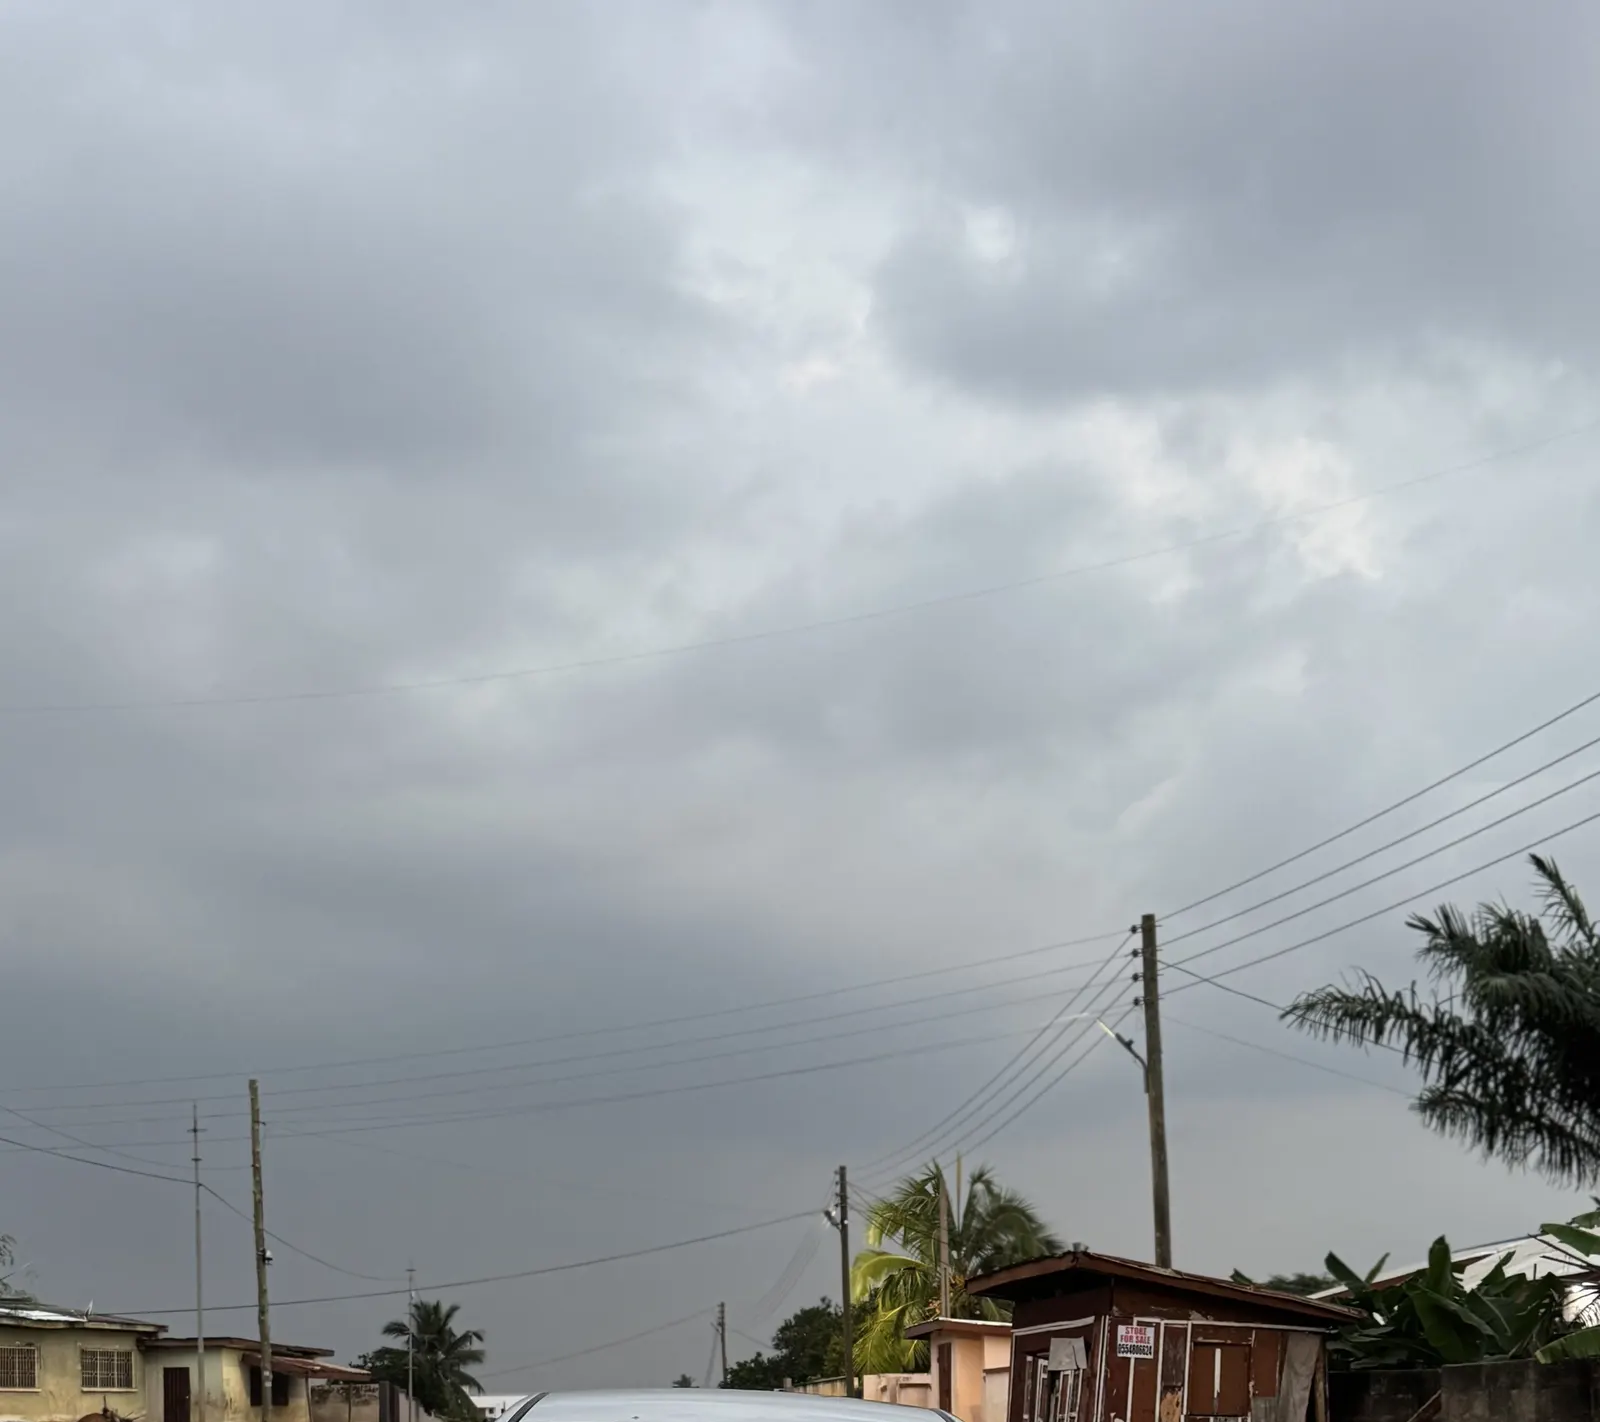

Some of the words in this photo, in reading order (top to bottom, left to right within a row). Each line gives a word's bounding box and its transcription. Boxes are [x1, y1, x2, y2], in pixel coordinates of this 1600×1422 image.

[1125, 1326, 1147, 1335] STORE
[1120, 1334, 1134, 1343] FOR
[1135, 1335, 1151, 1344] SALE
